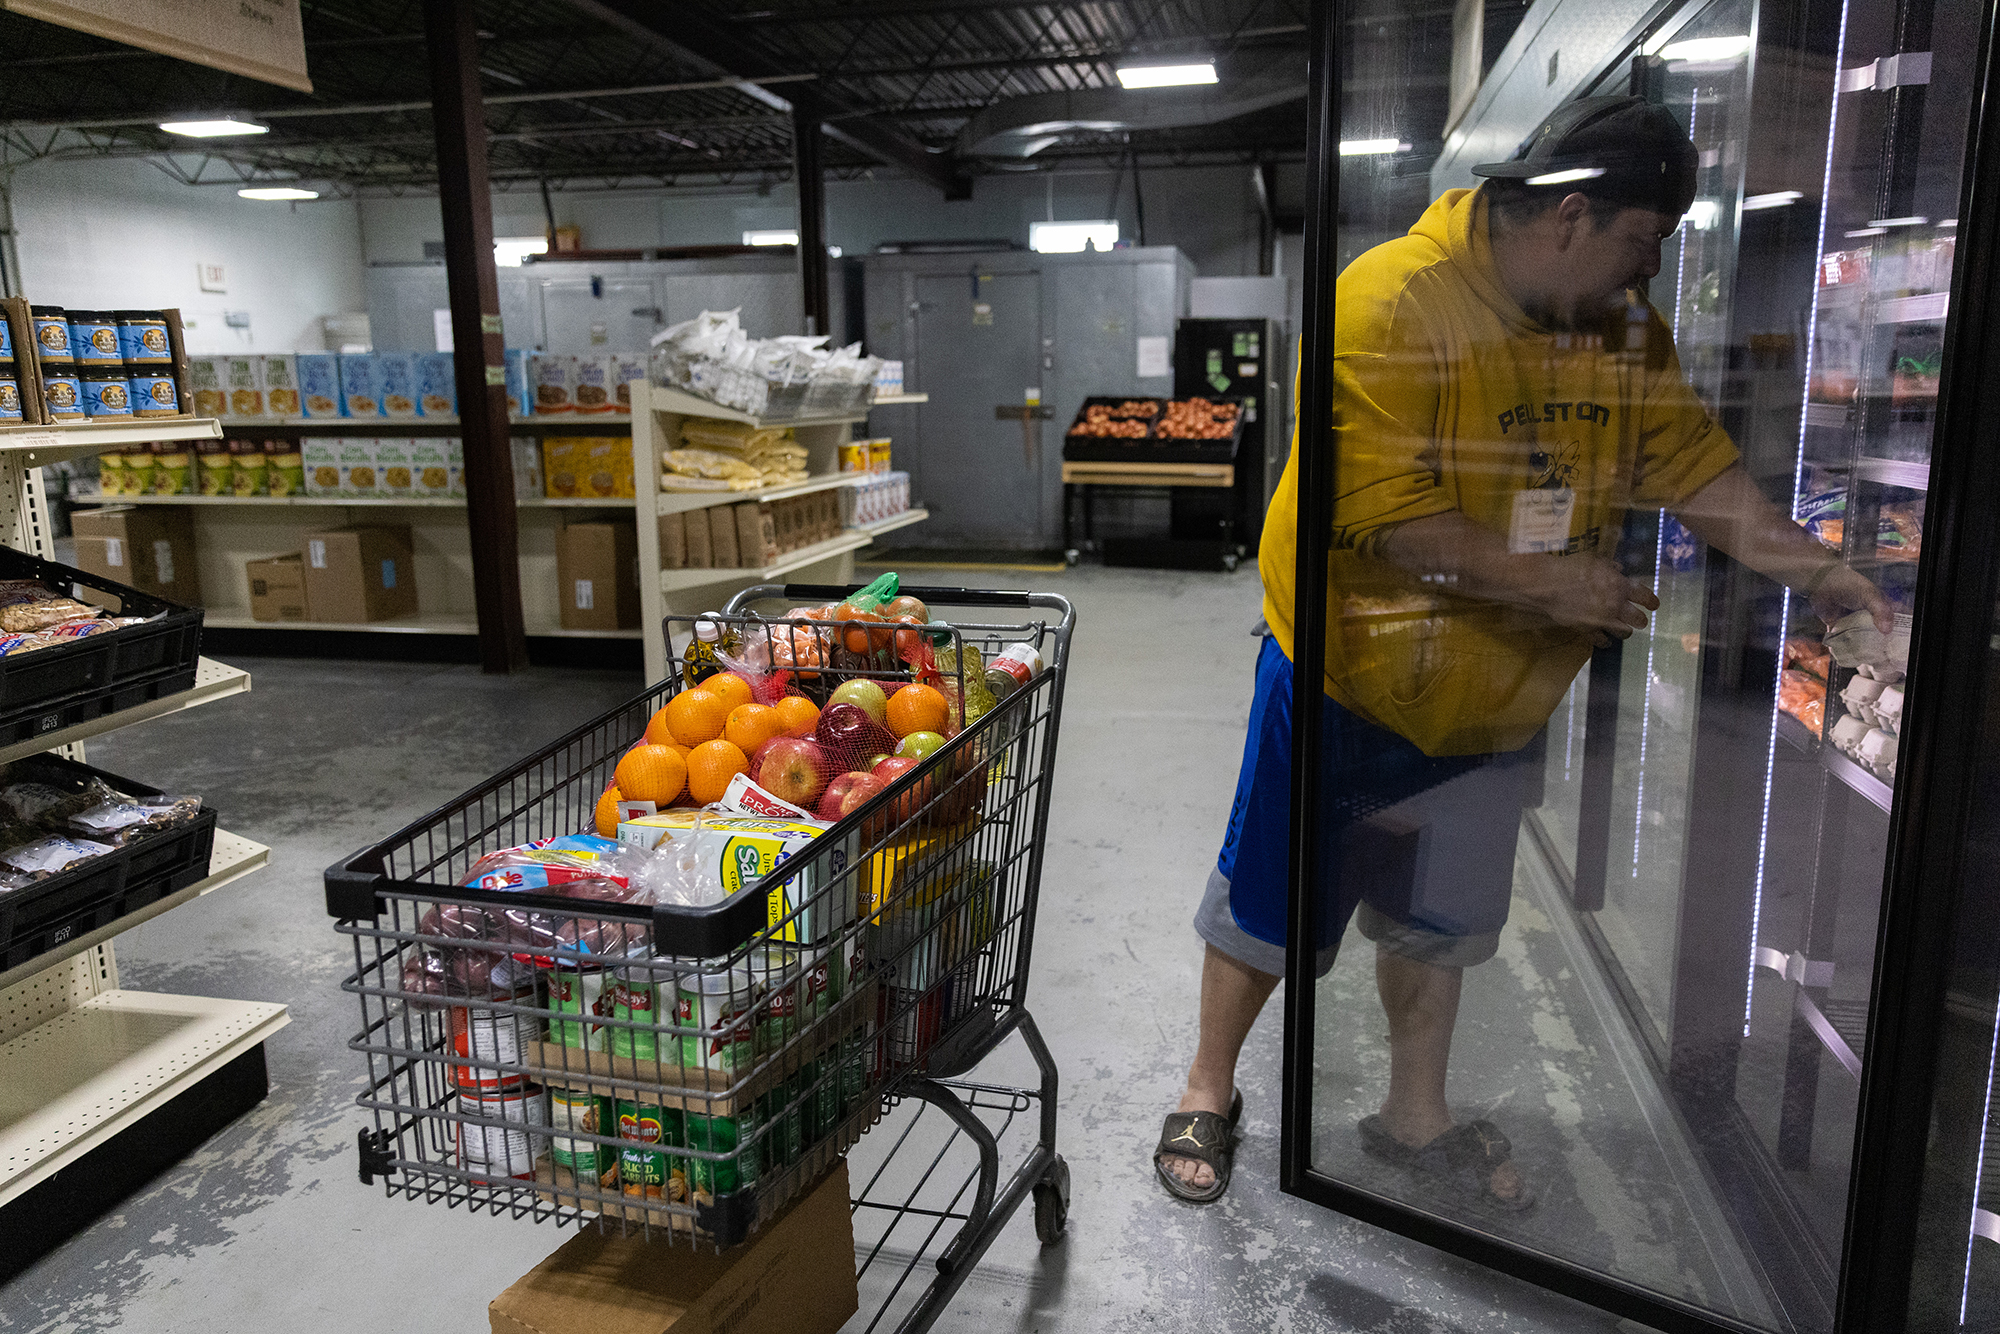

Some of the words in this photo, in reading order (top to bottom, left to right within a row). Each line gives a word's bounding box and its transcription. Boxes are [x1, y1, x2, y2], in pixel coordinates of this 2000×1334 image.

[738, 803, 751, 812] NET
[738, 847, 761, 885] Sal
[730, 871, 739, 893] crac
[770, 900, 778, 924] Tops
[631, 1126, 659, 1137] Mnte
